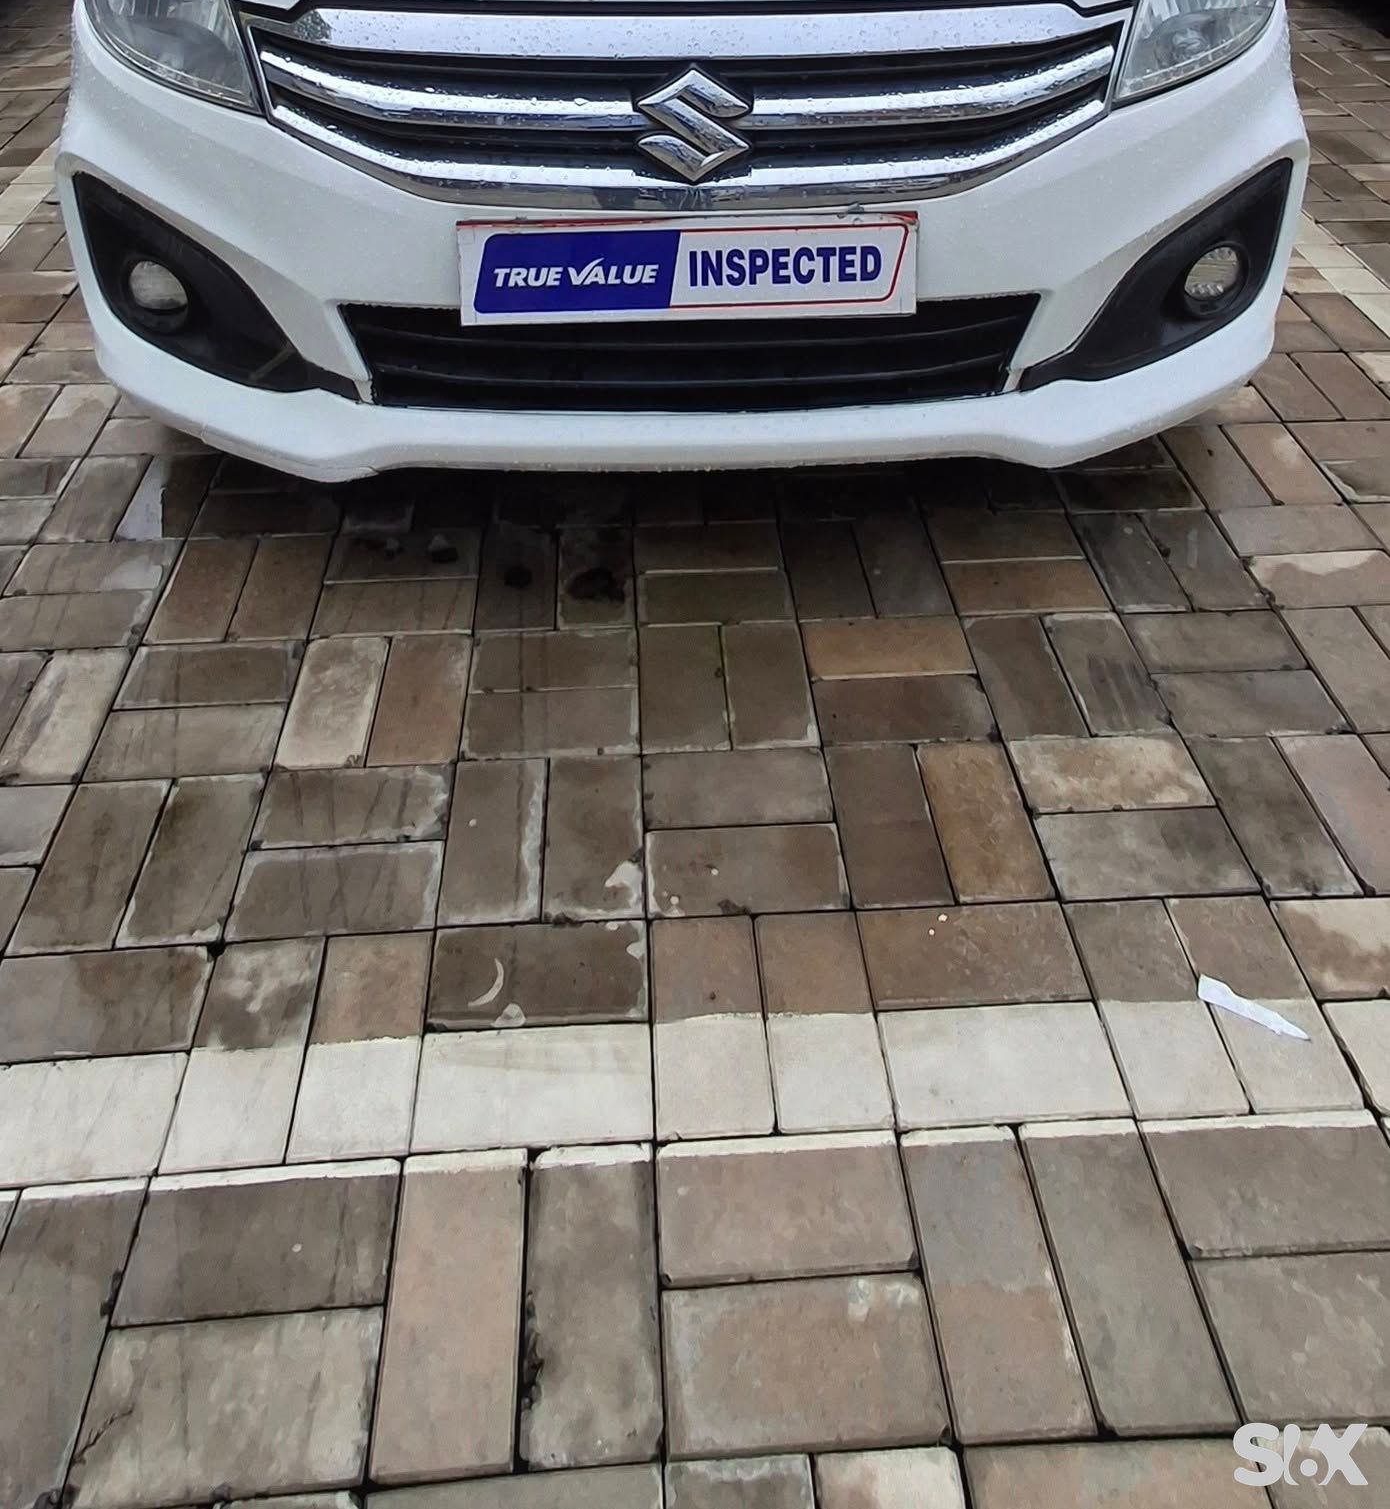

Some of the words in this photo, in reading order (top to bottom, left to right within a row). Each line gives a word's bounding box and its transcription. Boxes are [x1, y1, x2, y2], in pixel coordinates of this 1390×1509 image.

[493, 266, 563, 288] TRUE
[567, 257, 659, 286] VALUE
[688, 245, 882, 288] INSPECTED
